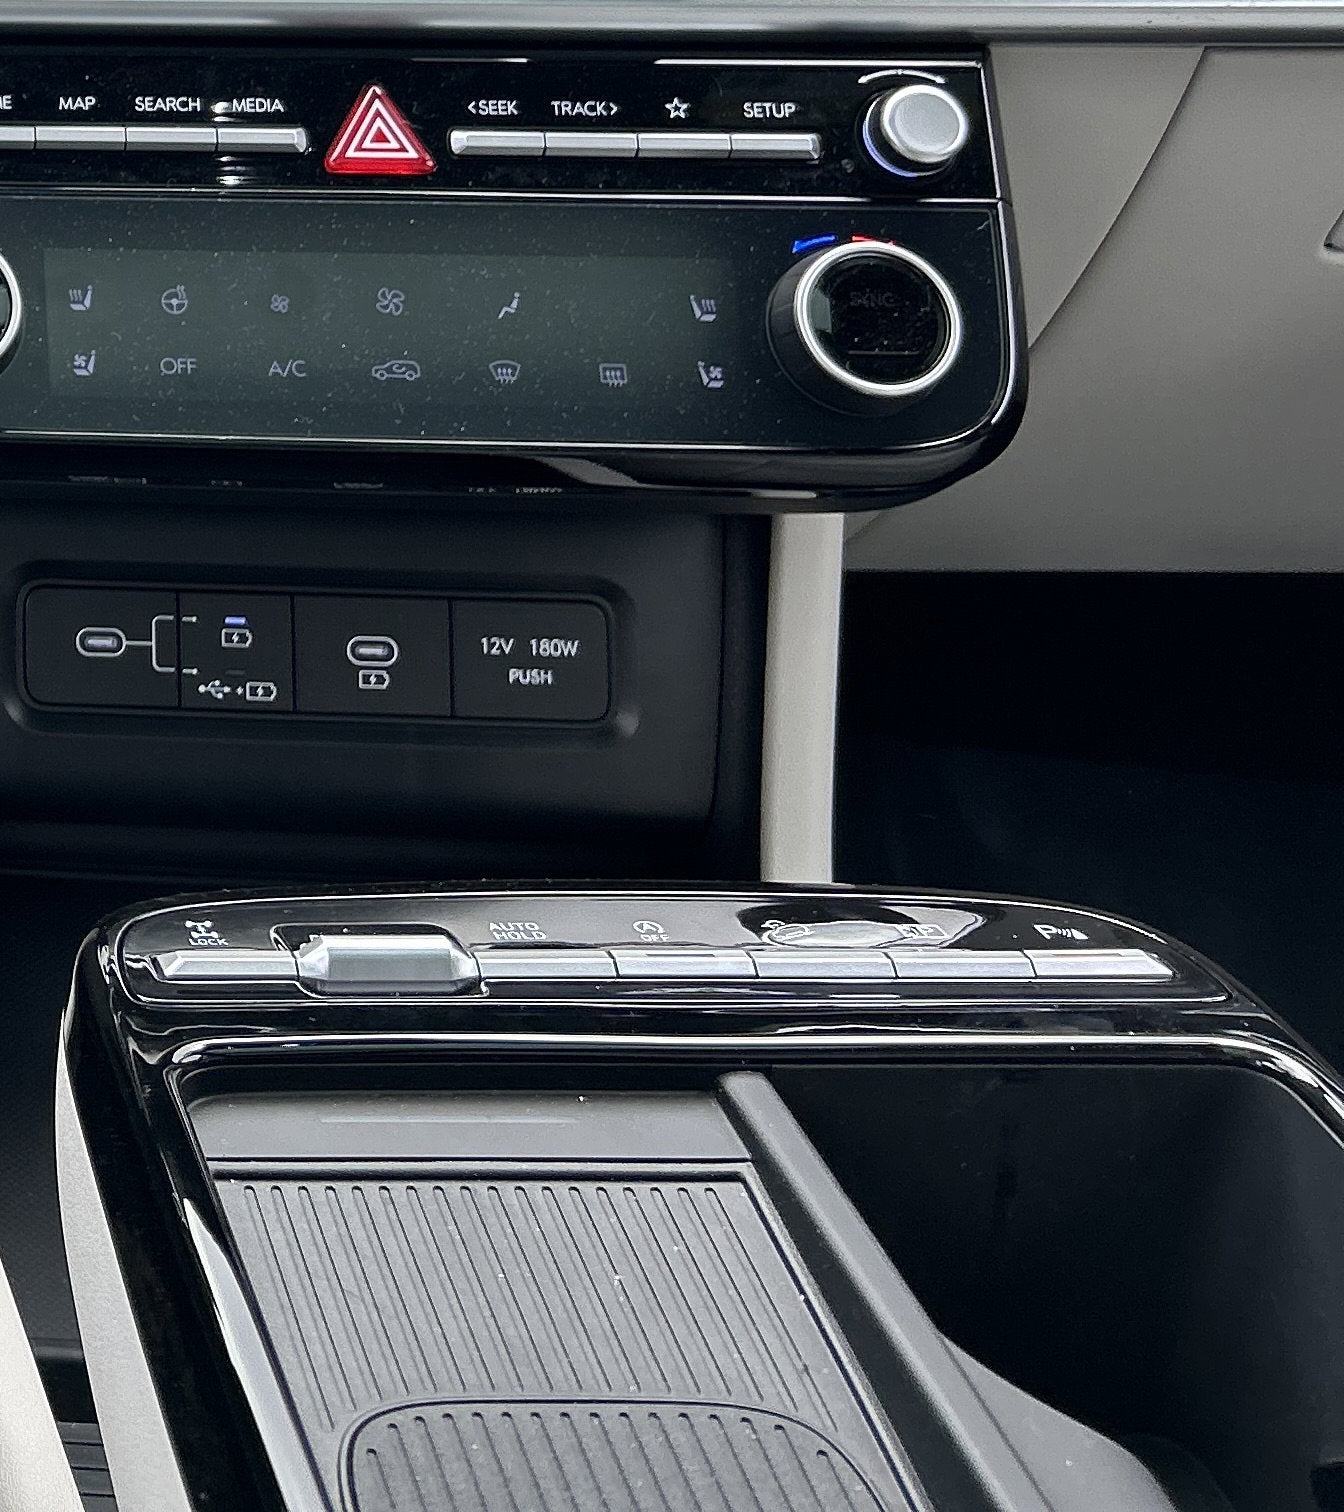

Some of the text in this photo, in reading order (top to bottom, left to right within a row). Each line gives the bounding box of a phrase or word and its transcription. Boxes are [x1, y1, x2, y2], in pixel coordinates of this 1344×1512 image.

[58, 96, 96, 111] MAP
[134, 96, 201, 112] SEARCH
[232, 97, 285, 113] MEDIA
[743, 102, 796, 118] SETUP
[159, 357, 198, 375] OFF
[268, 359, 307, 378] A/C
[480, 636, 580, 658] 12V 180W
[508, 668, 553, 685] PUSH
[489, 922, 541, 931] AUTO
[187, 937, 229, 946] LOCK
[493, 931, 547, 940] HOLD
[640, 934, 670, 942] OFF
